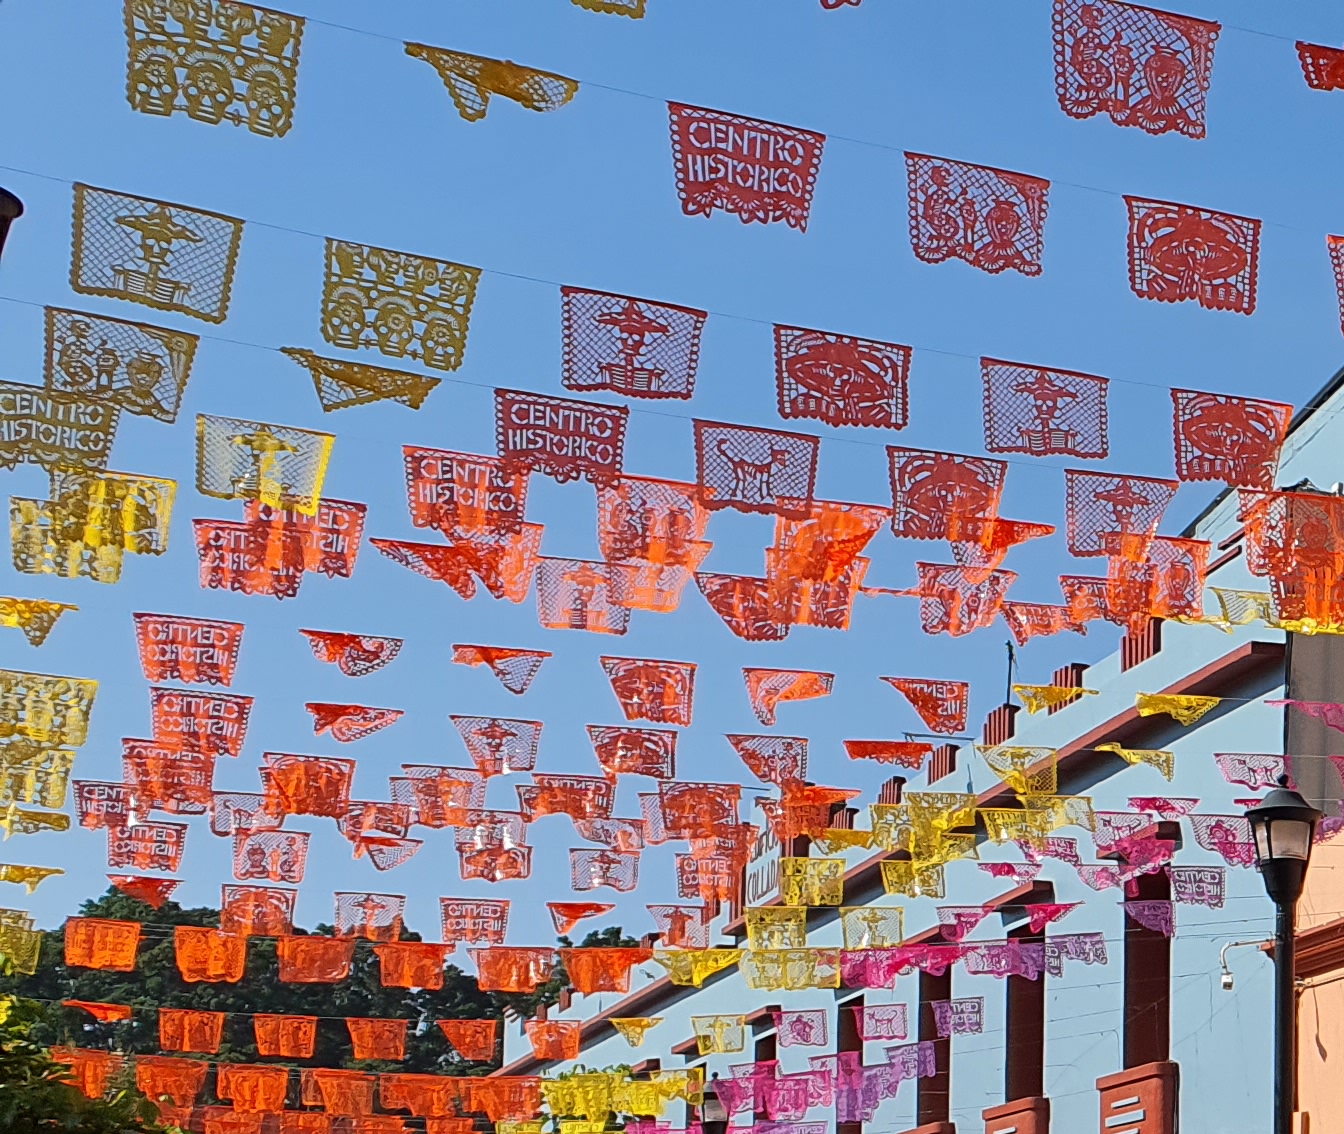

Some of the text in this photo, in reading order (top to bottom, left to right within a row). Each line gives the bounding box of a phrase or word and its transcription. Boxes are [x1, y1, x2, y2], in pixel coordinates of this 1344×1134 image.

[689, 121, 804, 166] CENTRO
[687, 154, 803, 198] HISTORICO
[0, 393, 105, 426] CENTRO
[508, 403, 613, 438] CENTRO
[508, 428, 614, 465] HISTORICO
[419, 458, 515, 488] CENTRO
[418, 481, 516, 512] HISTORICO
